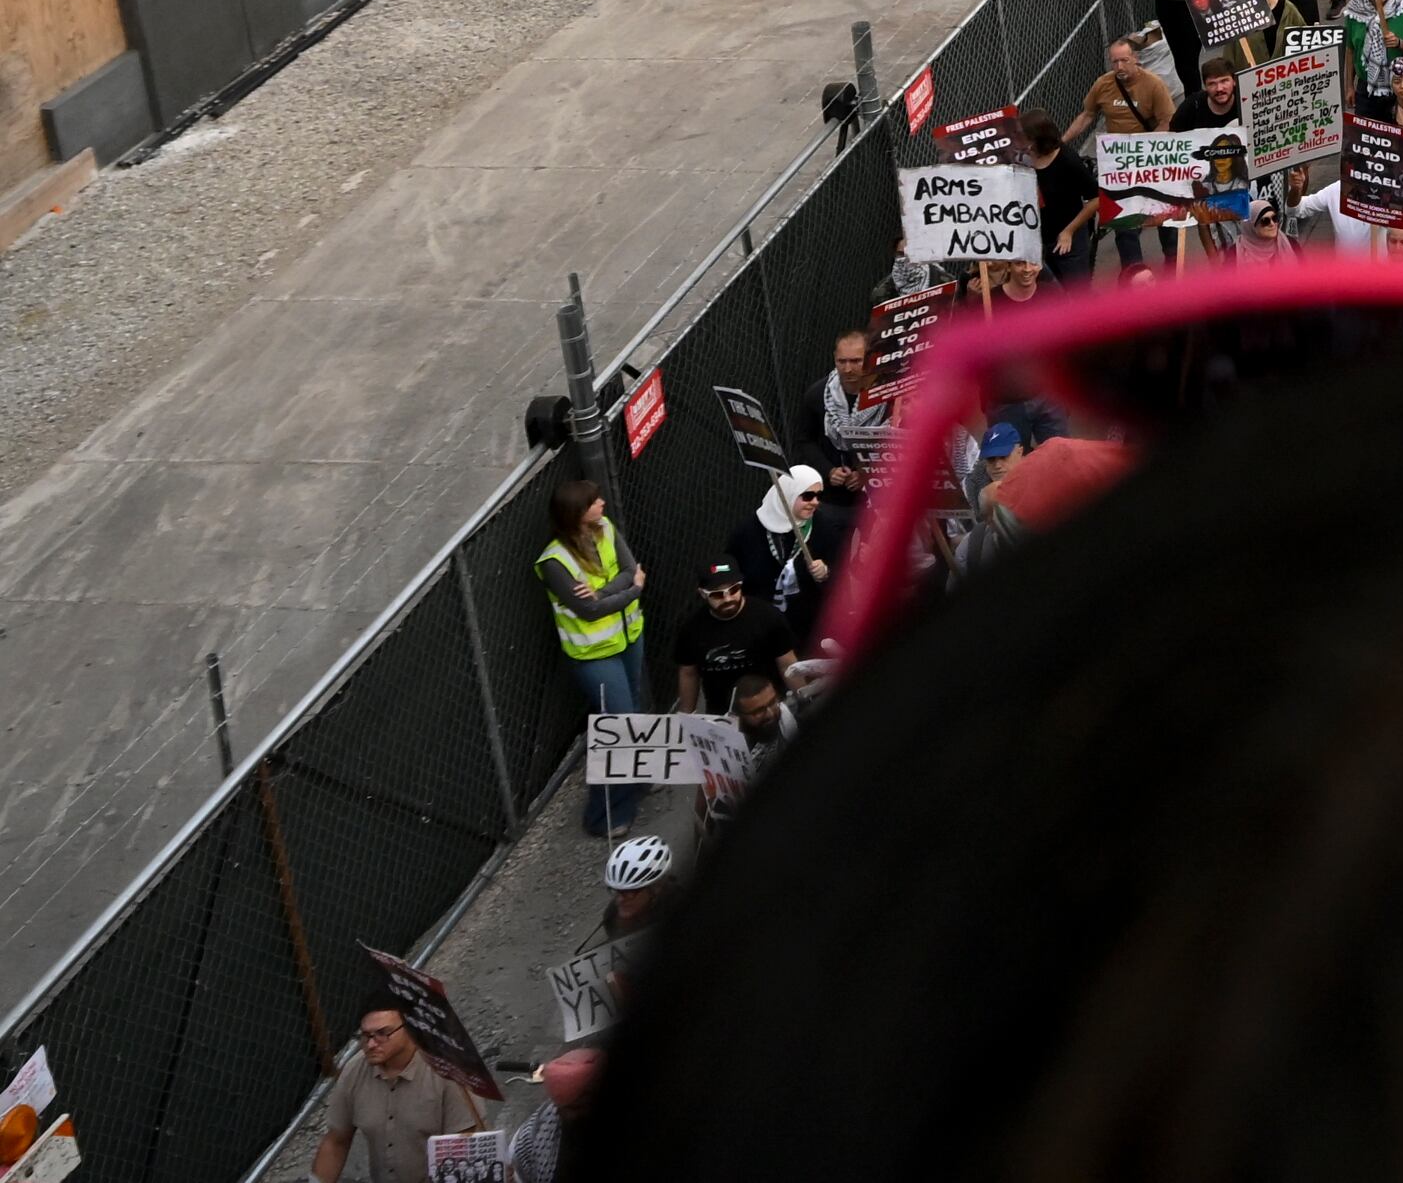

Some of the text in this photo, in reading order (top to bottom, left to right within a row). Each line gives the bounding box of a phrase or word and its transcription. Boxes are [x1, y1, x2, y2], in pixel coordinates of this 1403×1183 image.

[1286, 29, 1344, 48] CEASE
[1256, 53, 1330, 87] ISRAEL:
[1252, 69, 1338, 101] Killed 38 Palestinian
[1253, 104, 1340, 138] children since 10/7
[1102, 139, 1192, 154] WHILE YOU'RE
[1254, 132, 1340, 164] murder children
[1115, 152, 1189, 170] SPEAKING
[914, 176, 982, 200] ARMS
[1104, 165, 1202, 185] THEY ARE DYING
[924, 201, 1038, 228] EMBARGO
[948, 229, 1014, 256] NOW
[605, 749, 687, 779] LEF
